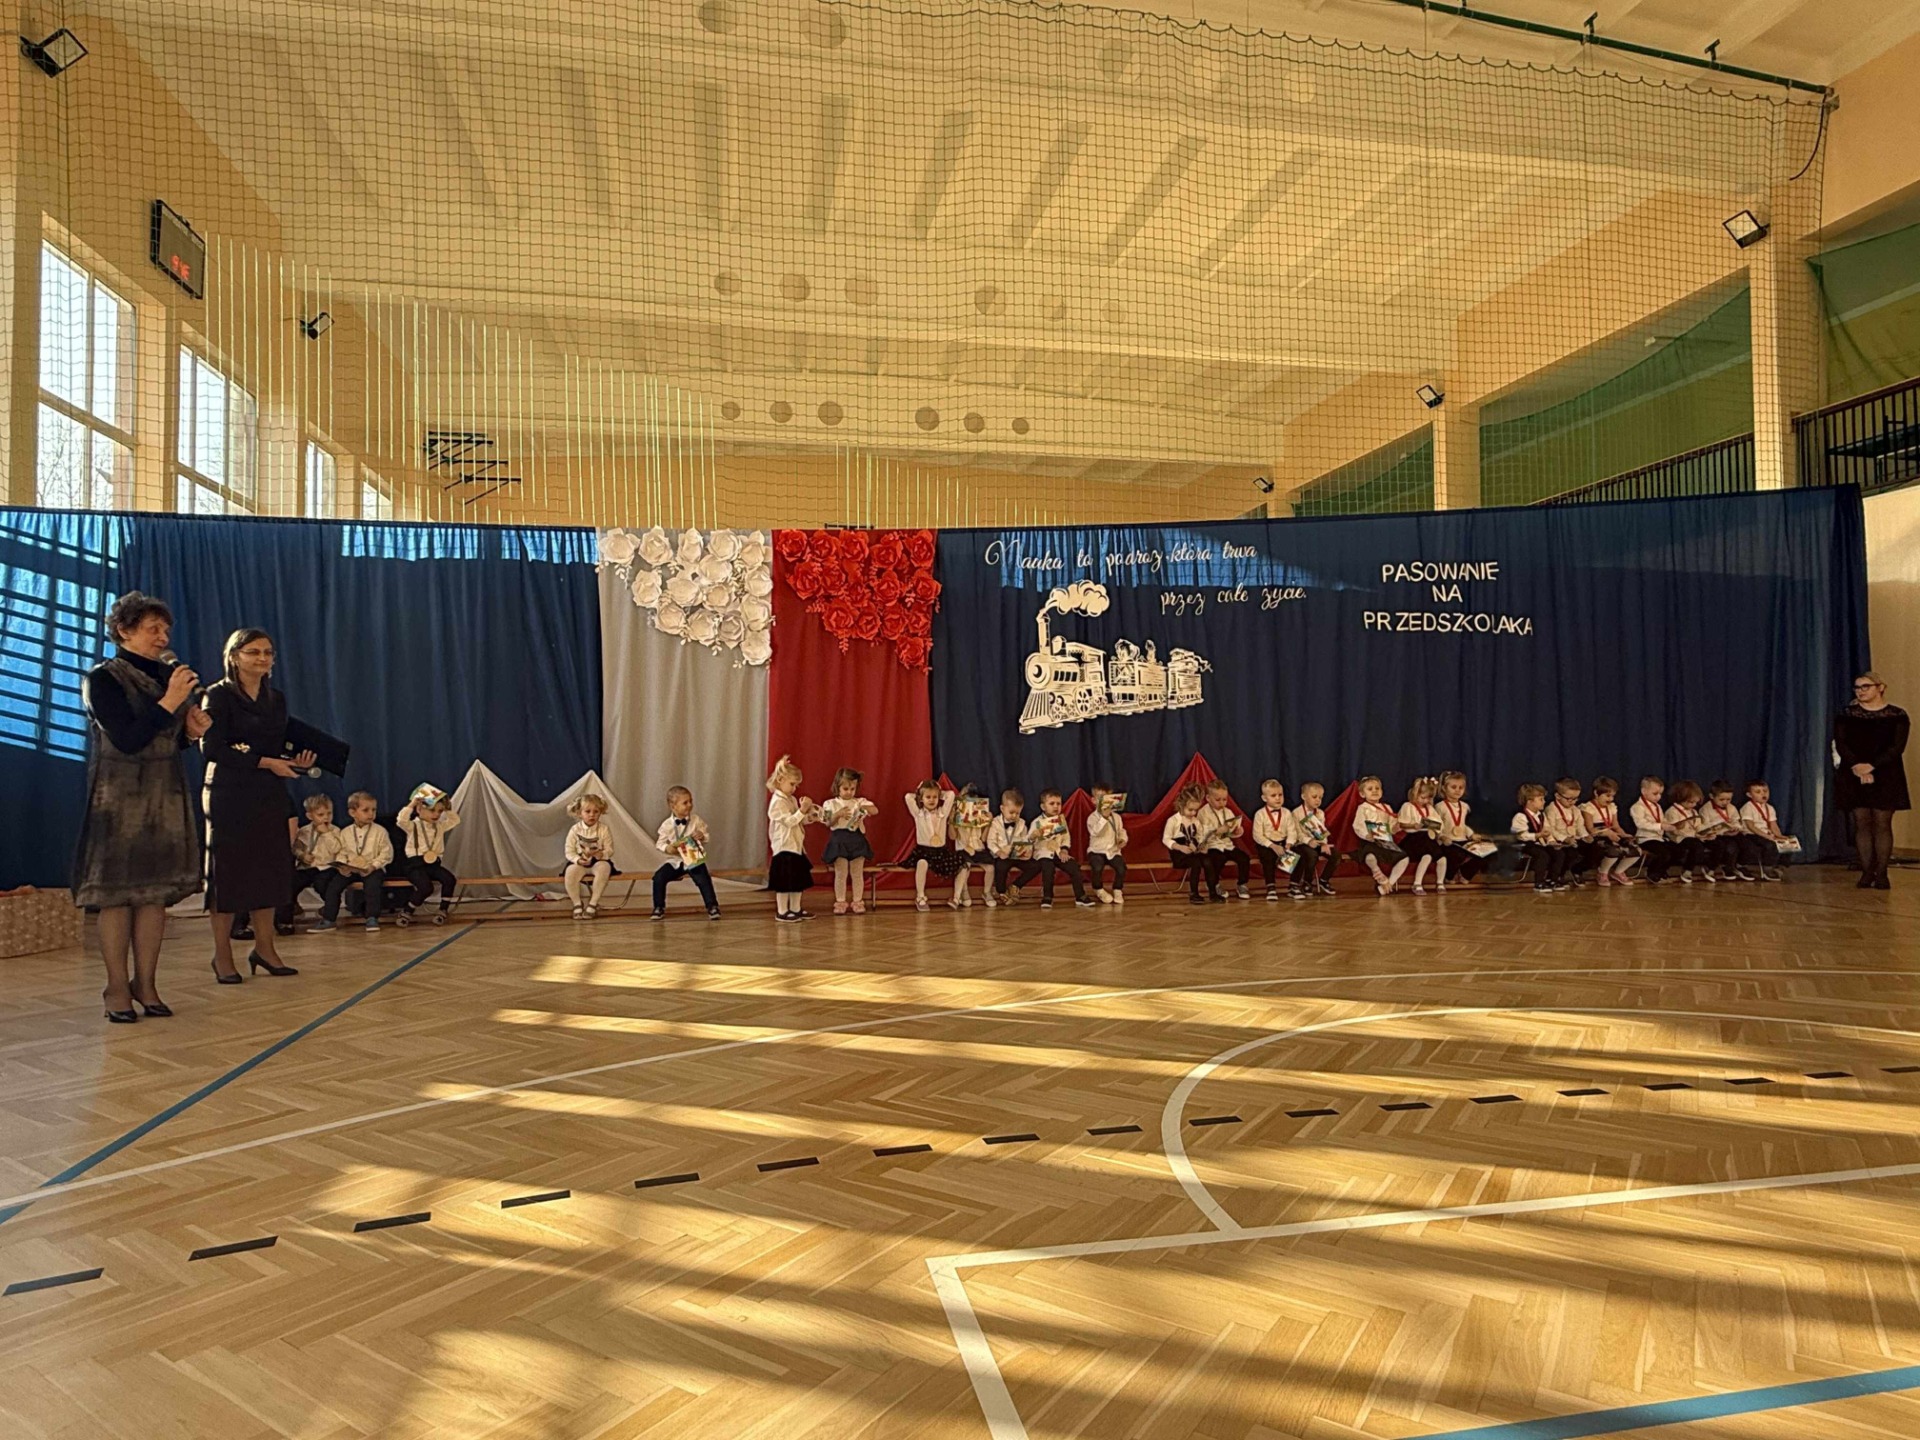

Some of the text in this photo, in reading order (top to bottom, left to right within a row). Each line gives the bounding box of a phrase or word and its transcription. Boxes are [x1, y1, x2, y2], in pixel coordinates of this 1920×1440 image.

[984, 539, 1064, 571] Nauka
[1077, 548, 1094, 568] to
[1222, 540, 1257, 560] trwa
[1382, 561, 1500, 583] PASOWANIE
[1160, 591, 1206, 617] przez
[1217, 582, 1249, 603] całe
[1432, 584, 1464, 603] NA
[1363, 610, 1533, 636] PRZEDSZKOLAKA
